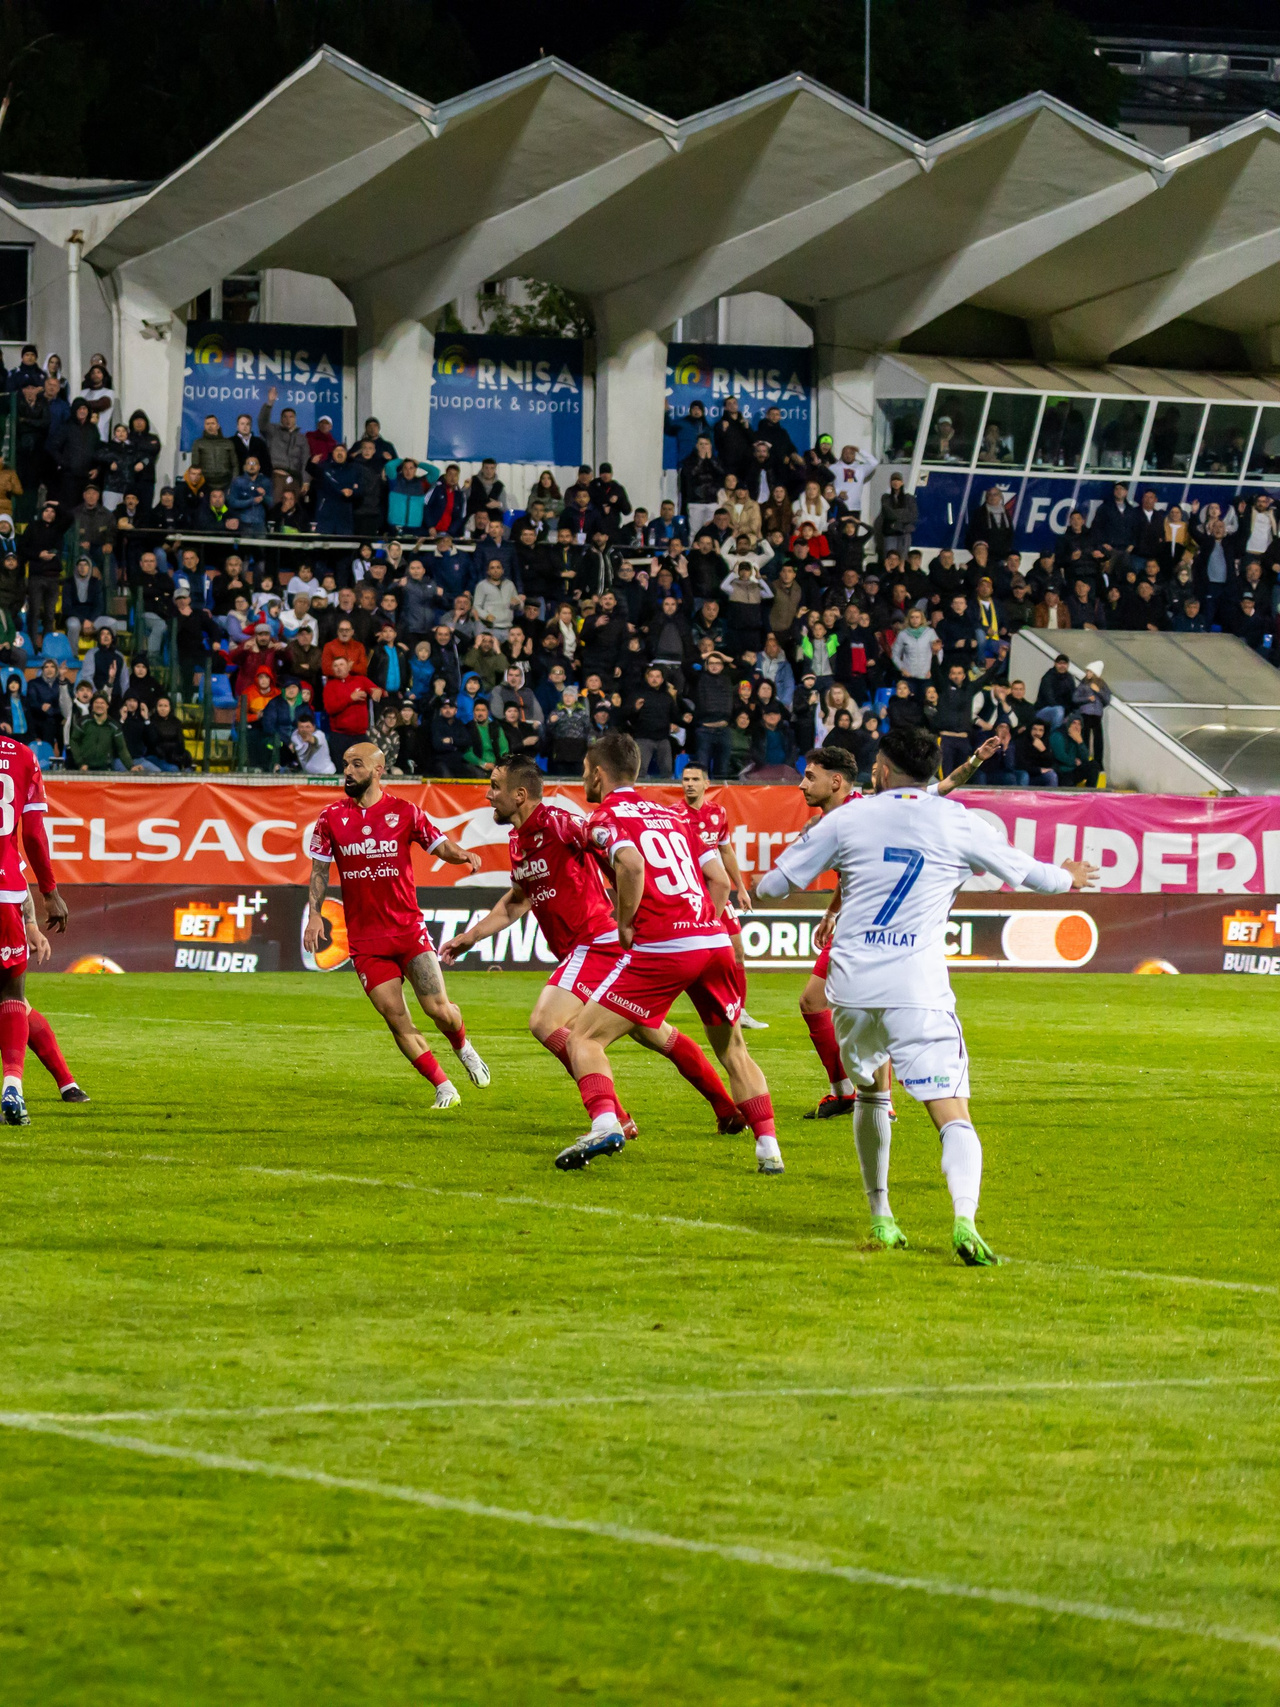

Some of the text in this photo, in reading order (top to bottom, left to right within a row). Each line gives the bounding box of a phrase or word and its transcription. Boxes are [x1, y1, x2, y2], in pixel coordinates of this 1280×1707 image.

[184, 385, 339, 404] quapark sports
[510, 396, 520, 411] &
[529, 400, 579, 414] sports
[743, 404, 752, 418] &
[760, 407, 807, 420] sorts
[339, 838, 398, 857] WIN2.RO
[640, 830, 704, 896] 98
[872, 847, 925, 926] 7
[180, 914, 221, 937] BET
[1227, 921, 1262, 943] BET
[864, 930, 918, 947] MAILAT
[175, 948, 259, 973] BUILDER
[1223, 953, 1280, 976] BUILDE
[577, 982, 593, 998] CARP
[606, 991, 651, 1019] CARPATINA
[905, 1075, 950, 1087] Smart Eco
